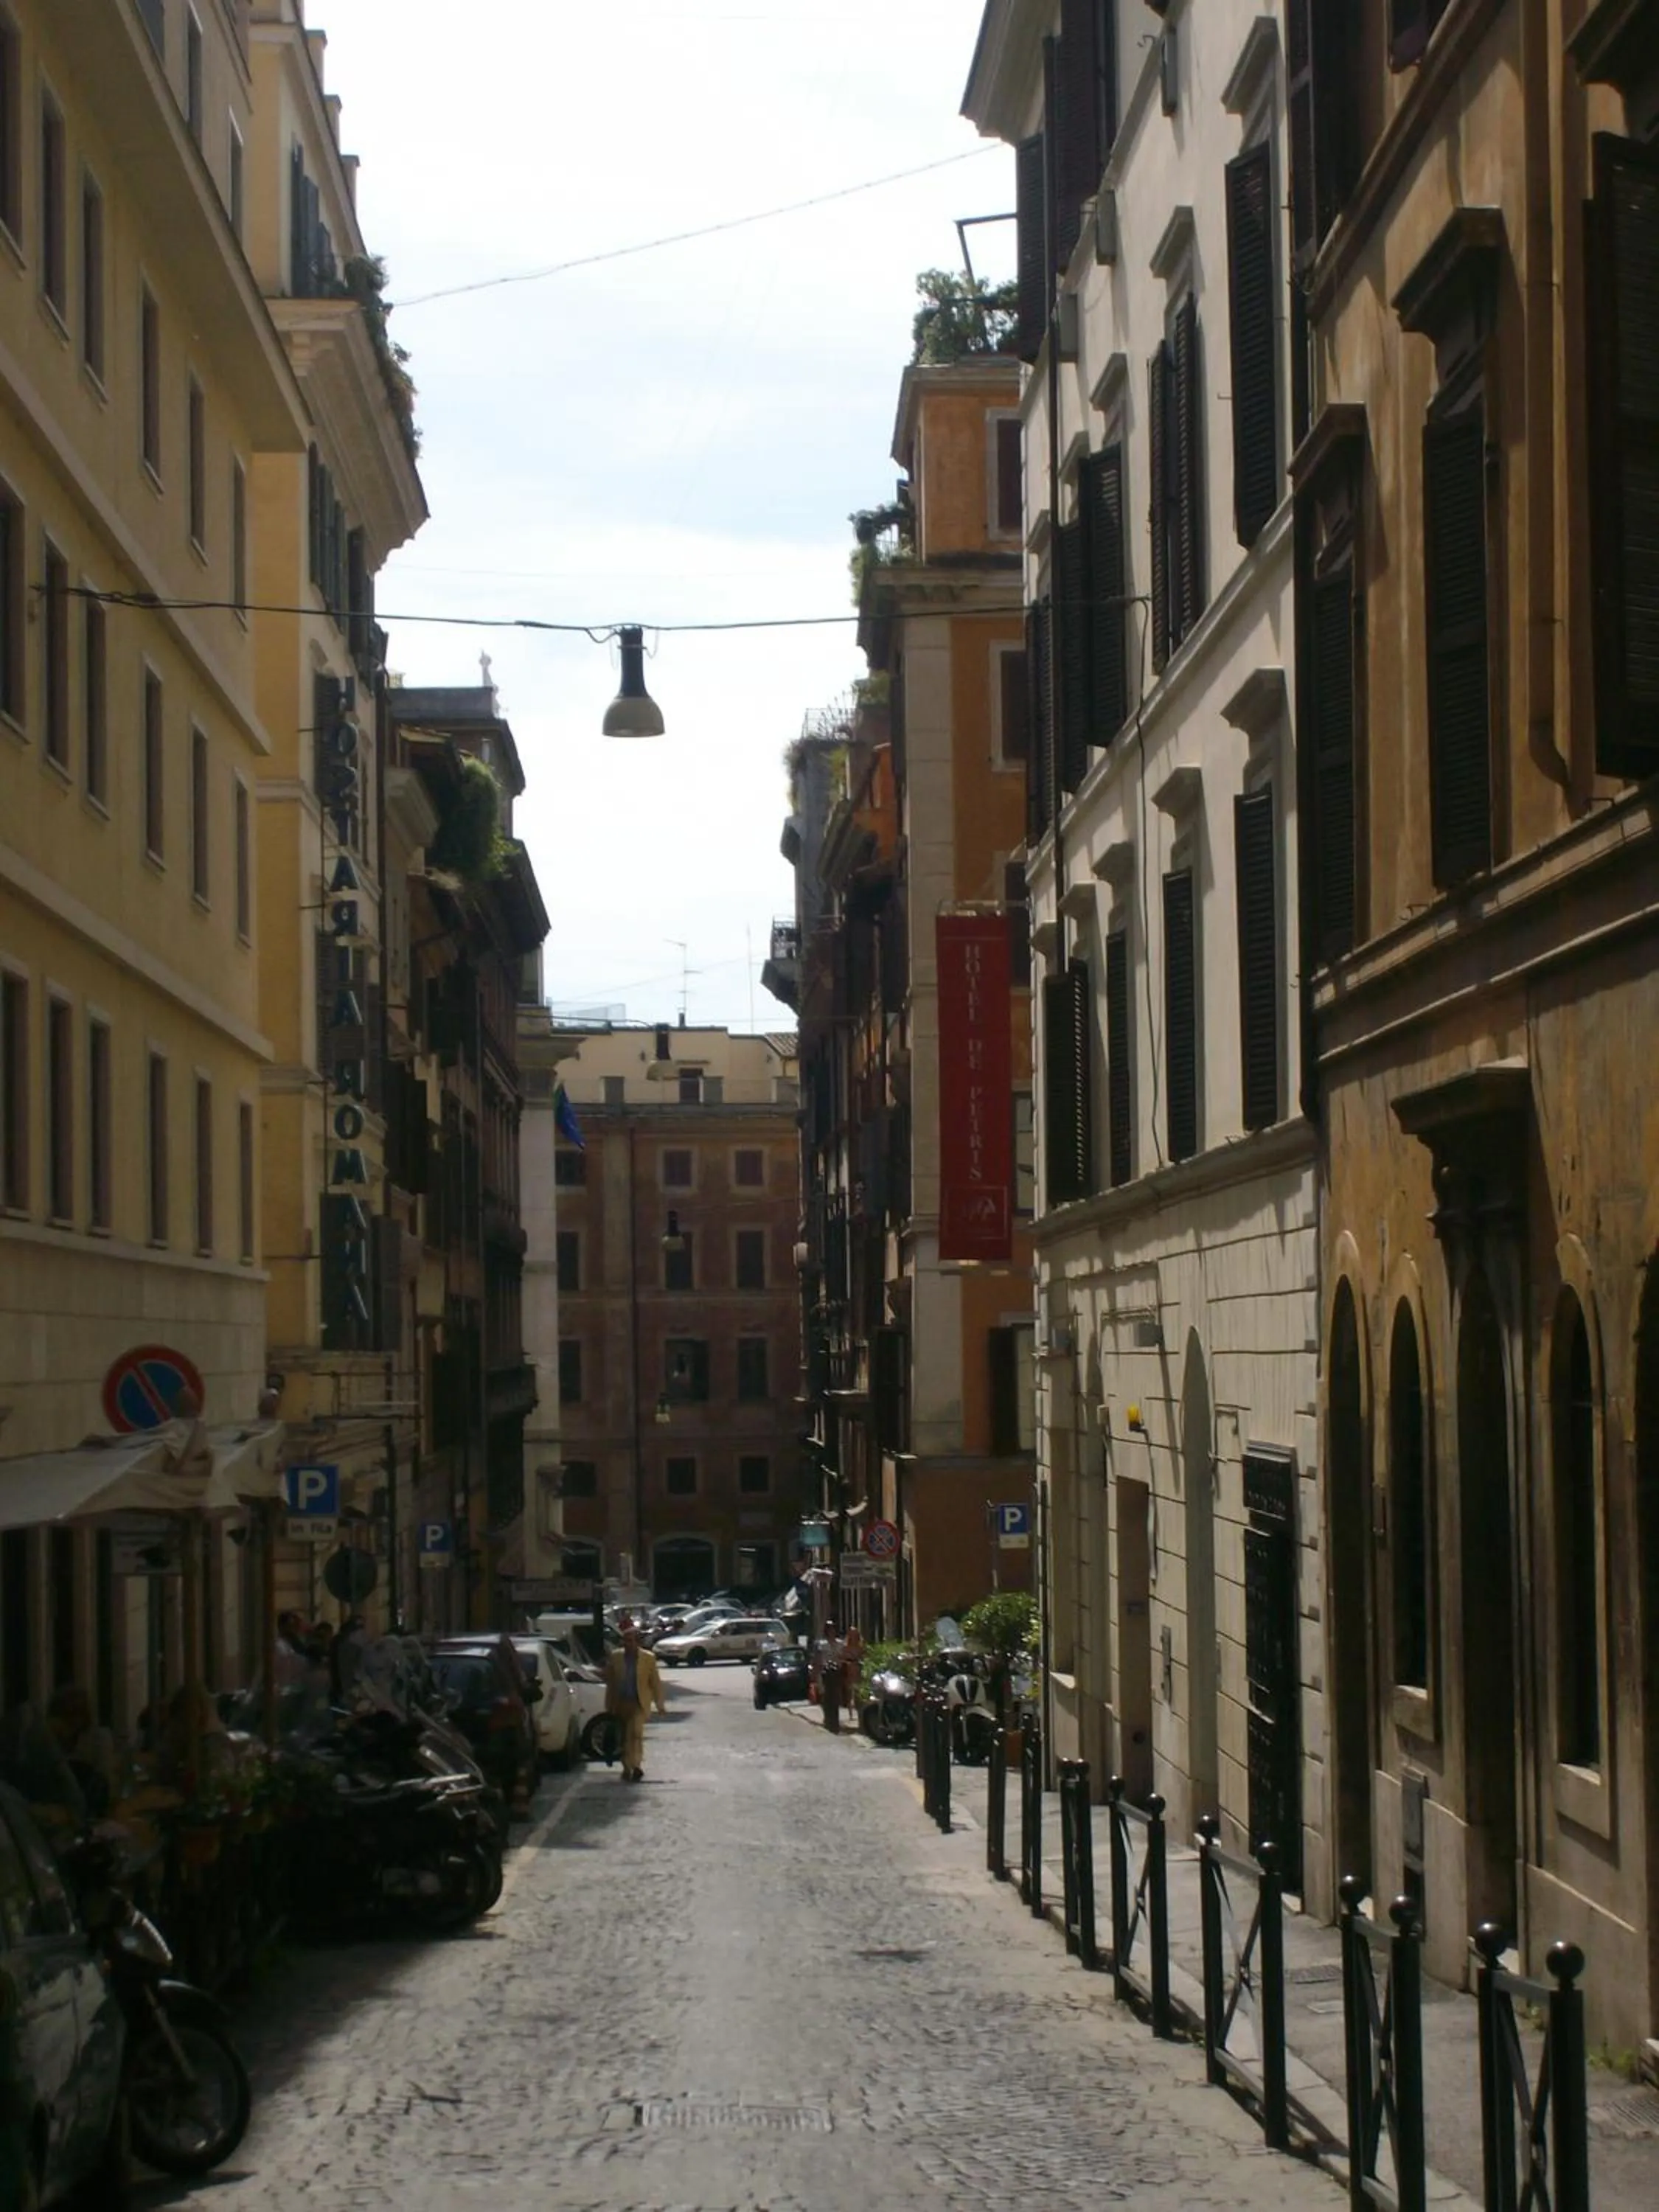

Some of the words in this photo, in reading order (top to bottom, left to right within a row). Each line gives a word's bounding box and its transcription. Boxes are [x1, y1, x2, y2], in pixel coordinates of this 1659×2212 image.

[964, 943, 982, 1021] HOTEL
[967, 1038, 984, 1071] DE
[968, 1085, 984, 1181] PETRIS
[297, 1470, 327, 1510] P
[425, 1524, 445, 1550] P
[1004, 1506, 1023, 1532] P
